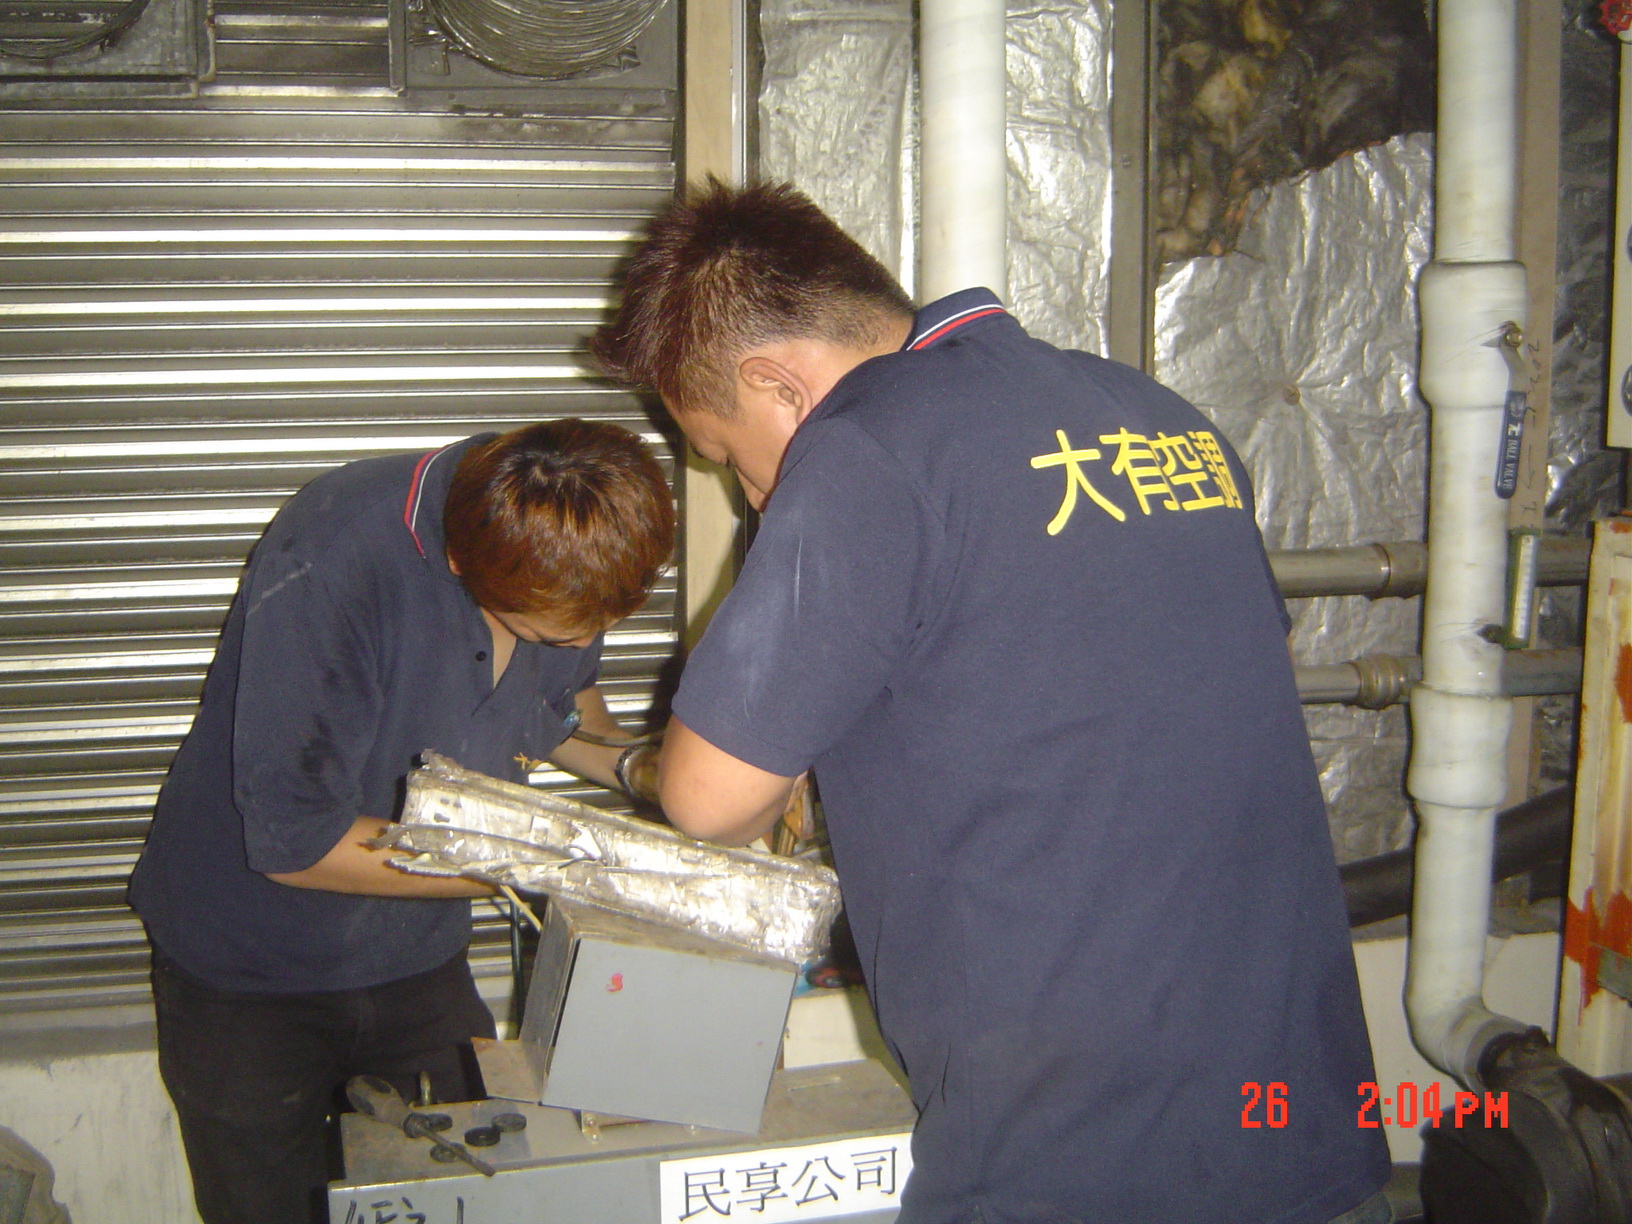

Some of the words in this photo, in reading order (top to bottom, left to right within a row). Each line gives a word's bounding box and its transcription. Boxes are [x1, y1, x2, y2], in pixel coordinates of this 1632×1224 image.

[1506, 439, 1518, 459] BALL
[1030, 426, 1243, 536] 大有空調
[1503, 463, 1515, 490] VALVE
[678, 1145, 898, 1222] 民享公司
